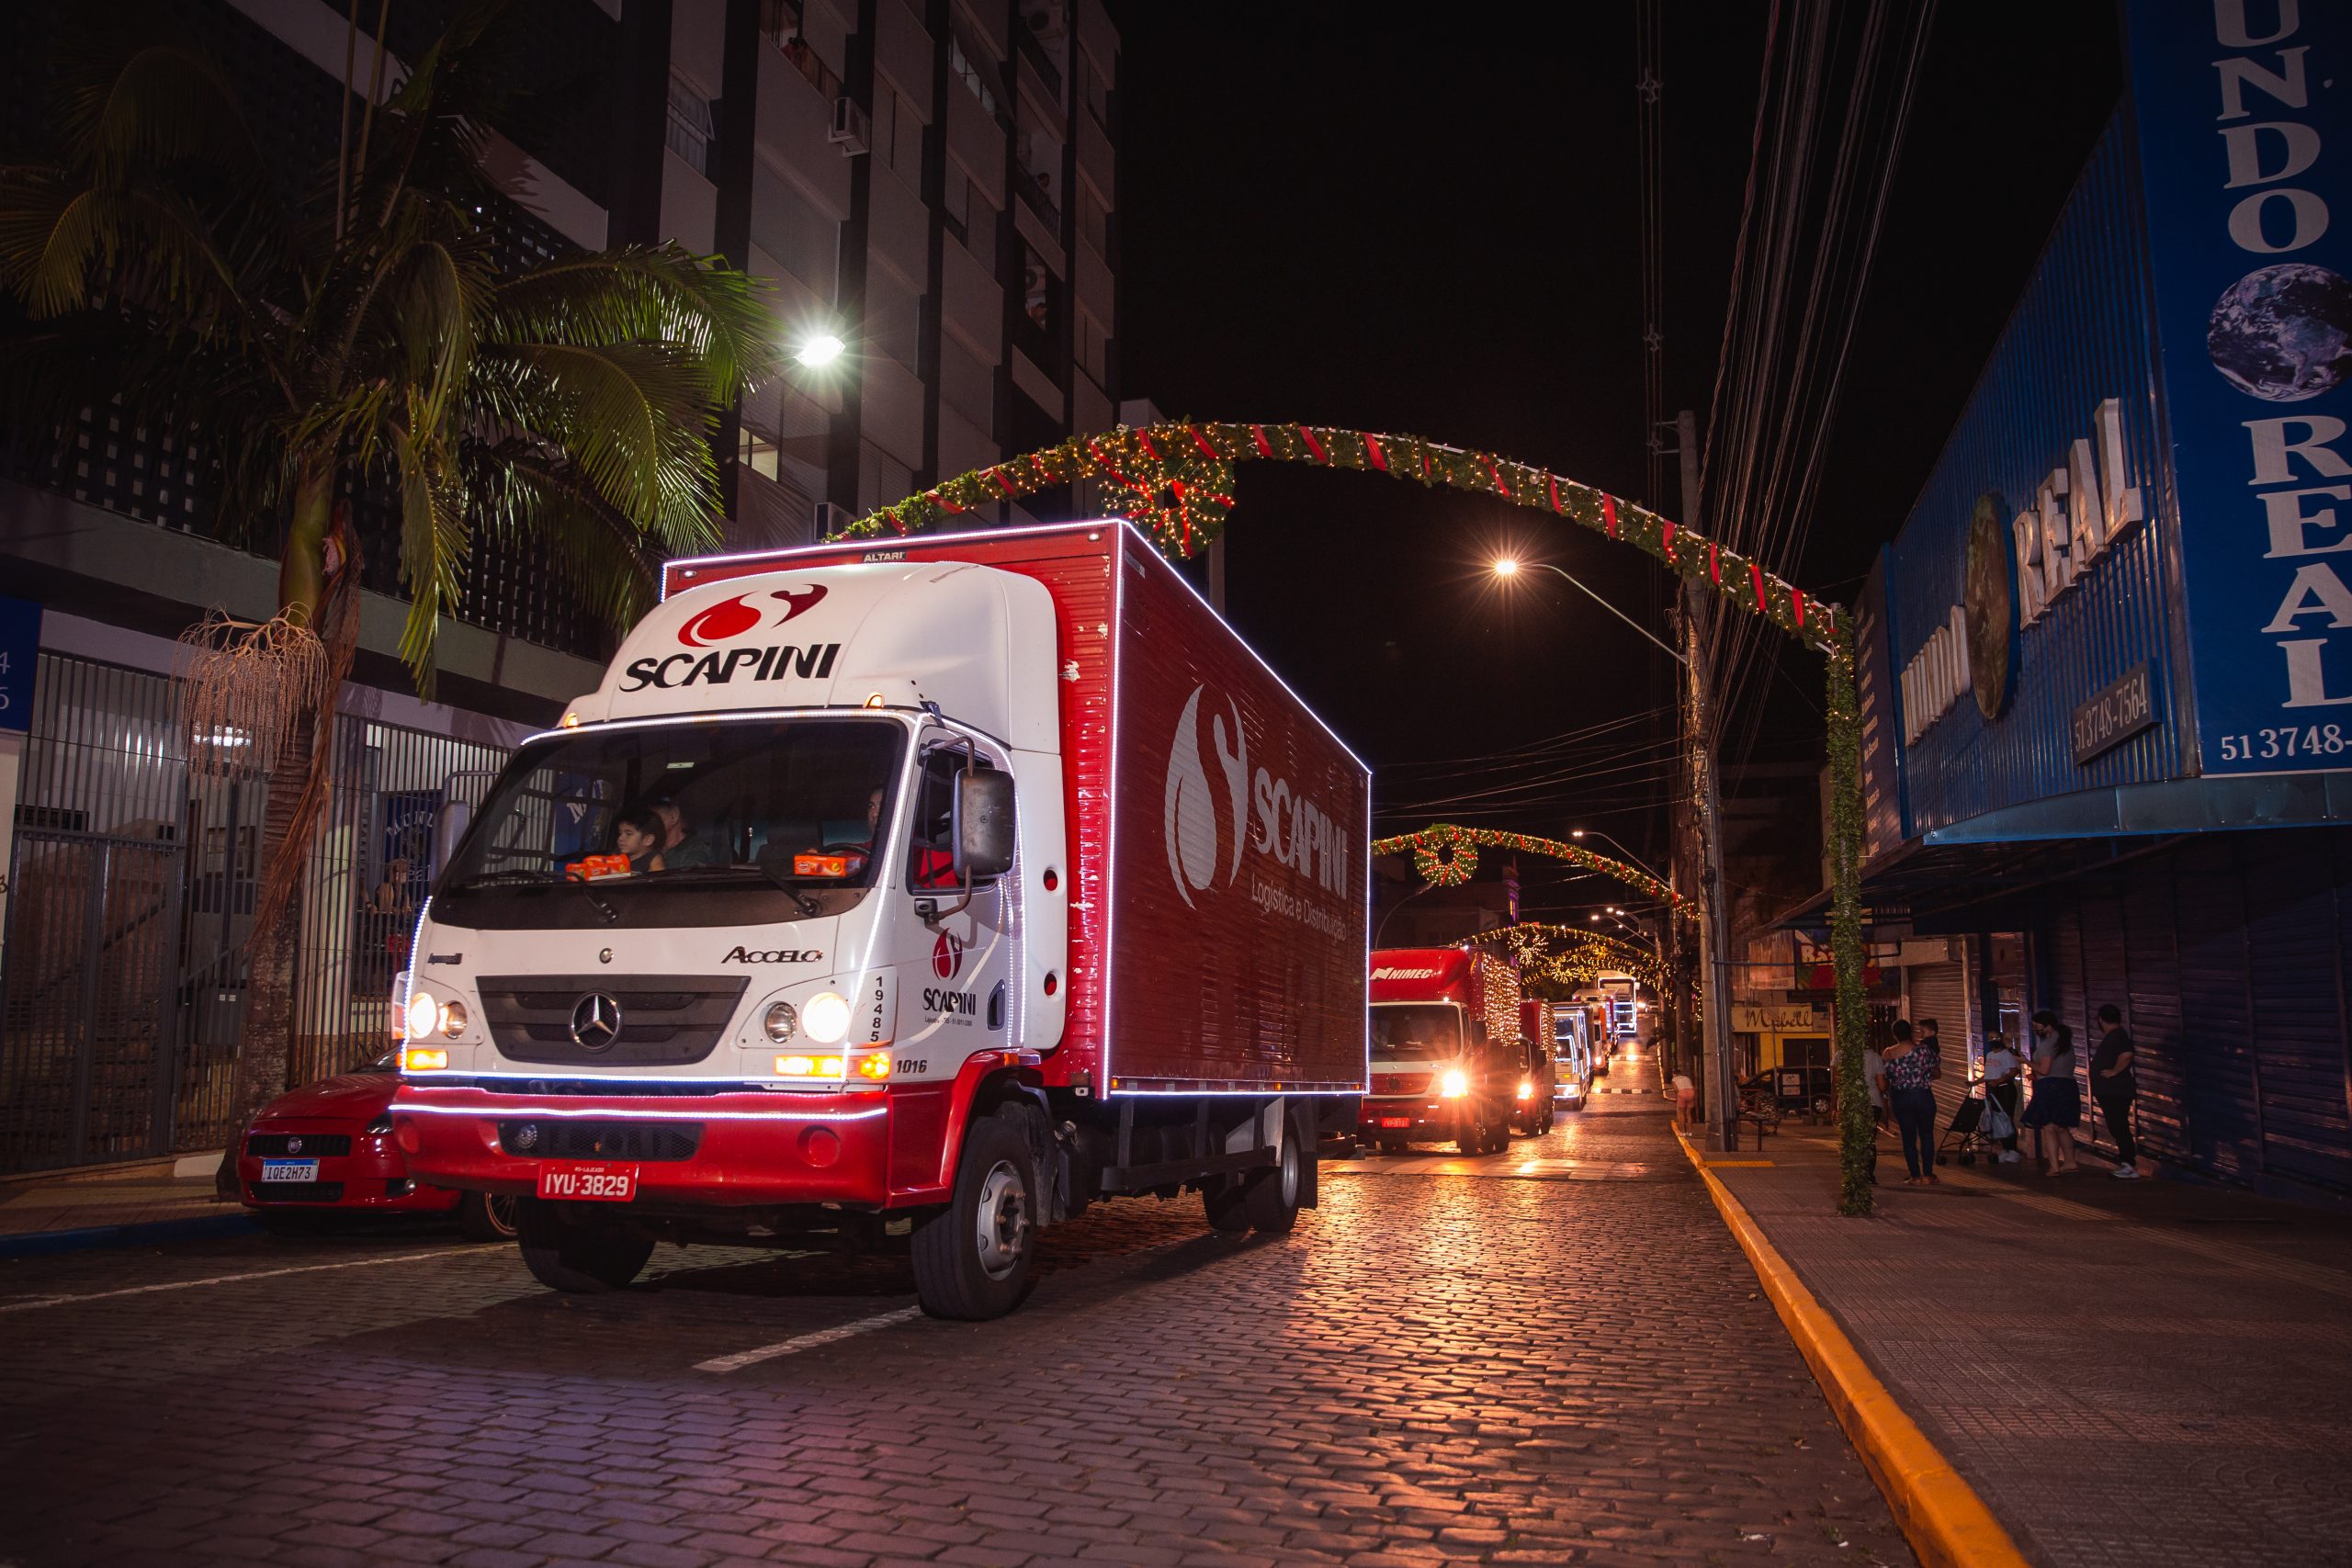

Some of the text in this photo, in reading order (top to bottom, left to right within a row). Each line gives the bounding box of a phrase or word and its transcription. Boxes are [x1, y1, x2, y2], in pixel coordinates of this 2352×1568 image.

[2013, 398, 2143, 632] REAL
[2241, 415, 2352, 708] REAL
[619, 643, 841, 692] SCAPINI
[2222, 735, 2253, 761] 51
[1255, 766, 1347, 900] SCAPINI
[870, 976, 884, 1042] 19485
[922, 987, 976, 1015] SCAPINI
[897, 1059, 927, 1073] 1016
[545, 1174, 629, 1196] IYU-3829
